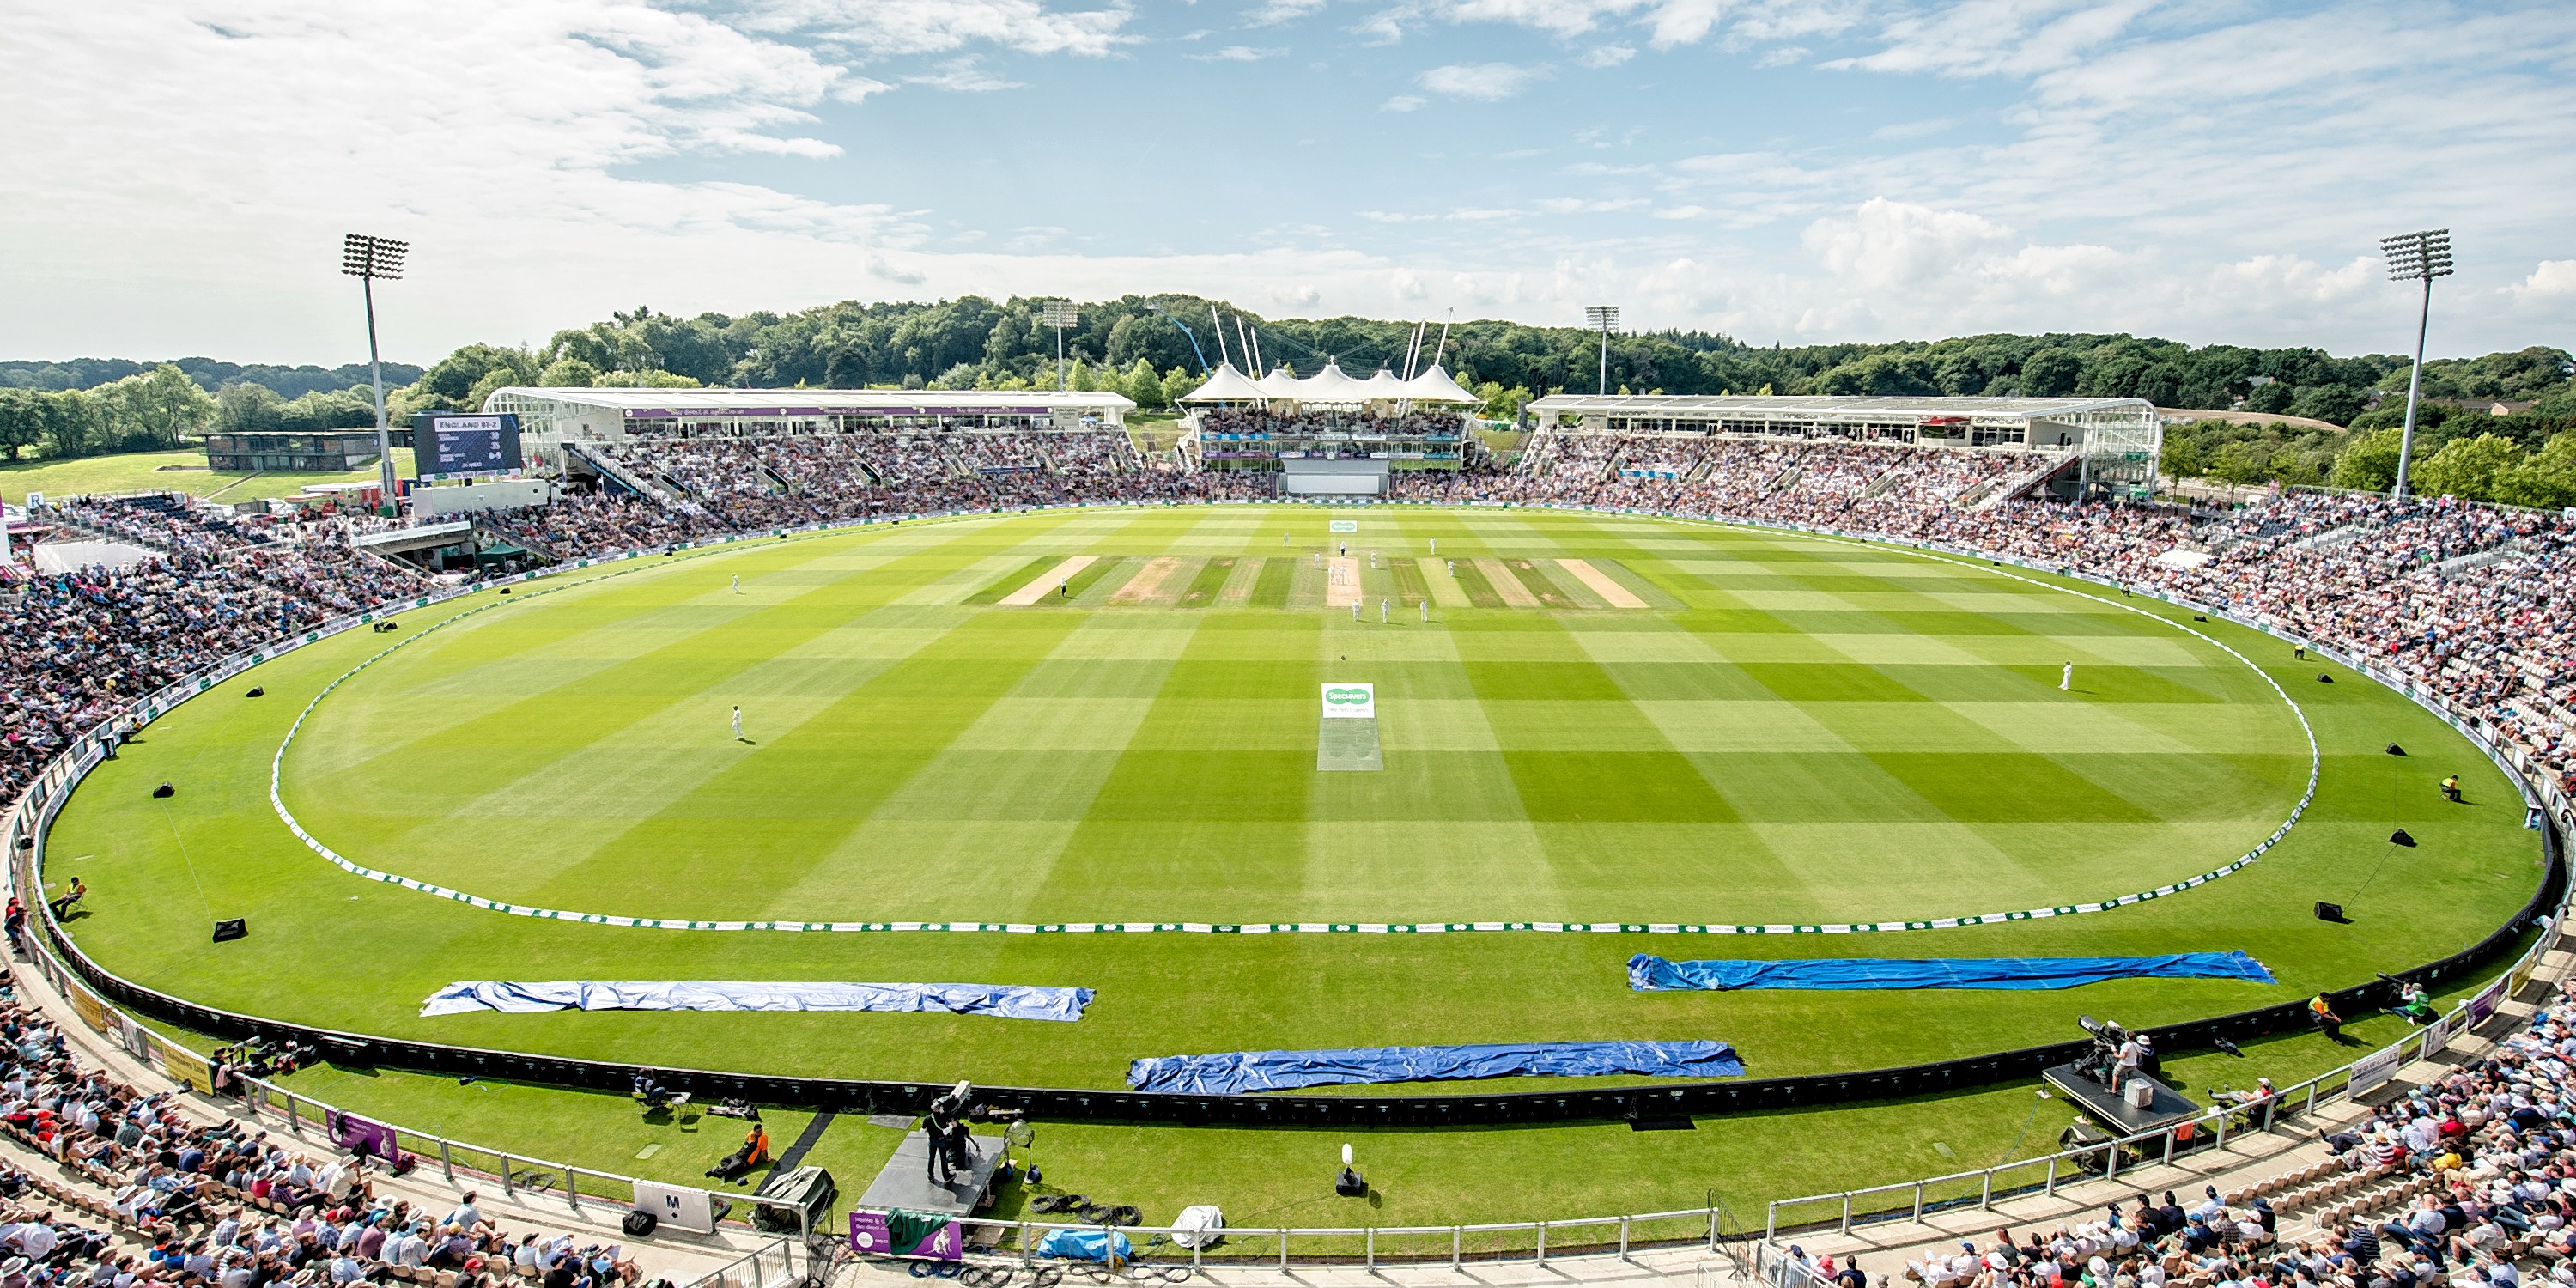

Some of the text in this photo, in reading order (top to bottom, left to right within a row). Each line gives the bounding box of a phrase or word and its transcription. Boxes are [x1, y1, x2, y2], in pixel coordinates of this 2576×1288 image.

[439, 421, 479, 429] ENGLAND
[31, 495, 40, 507] R
[1328, 692, 1367, 701] Specsavers
[165, 1048, 206, 1075] Chequers Inn
[666, 1194, 681, 1209] M
